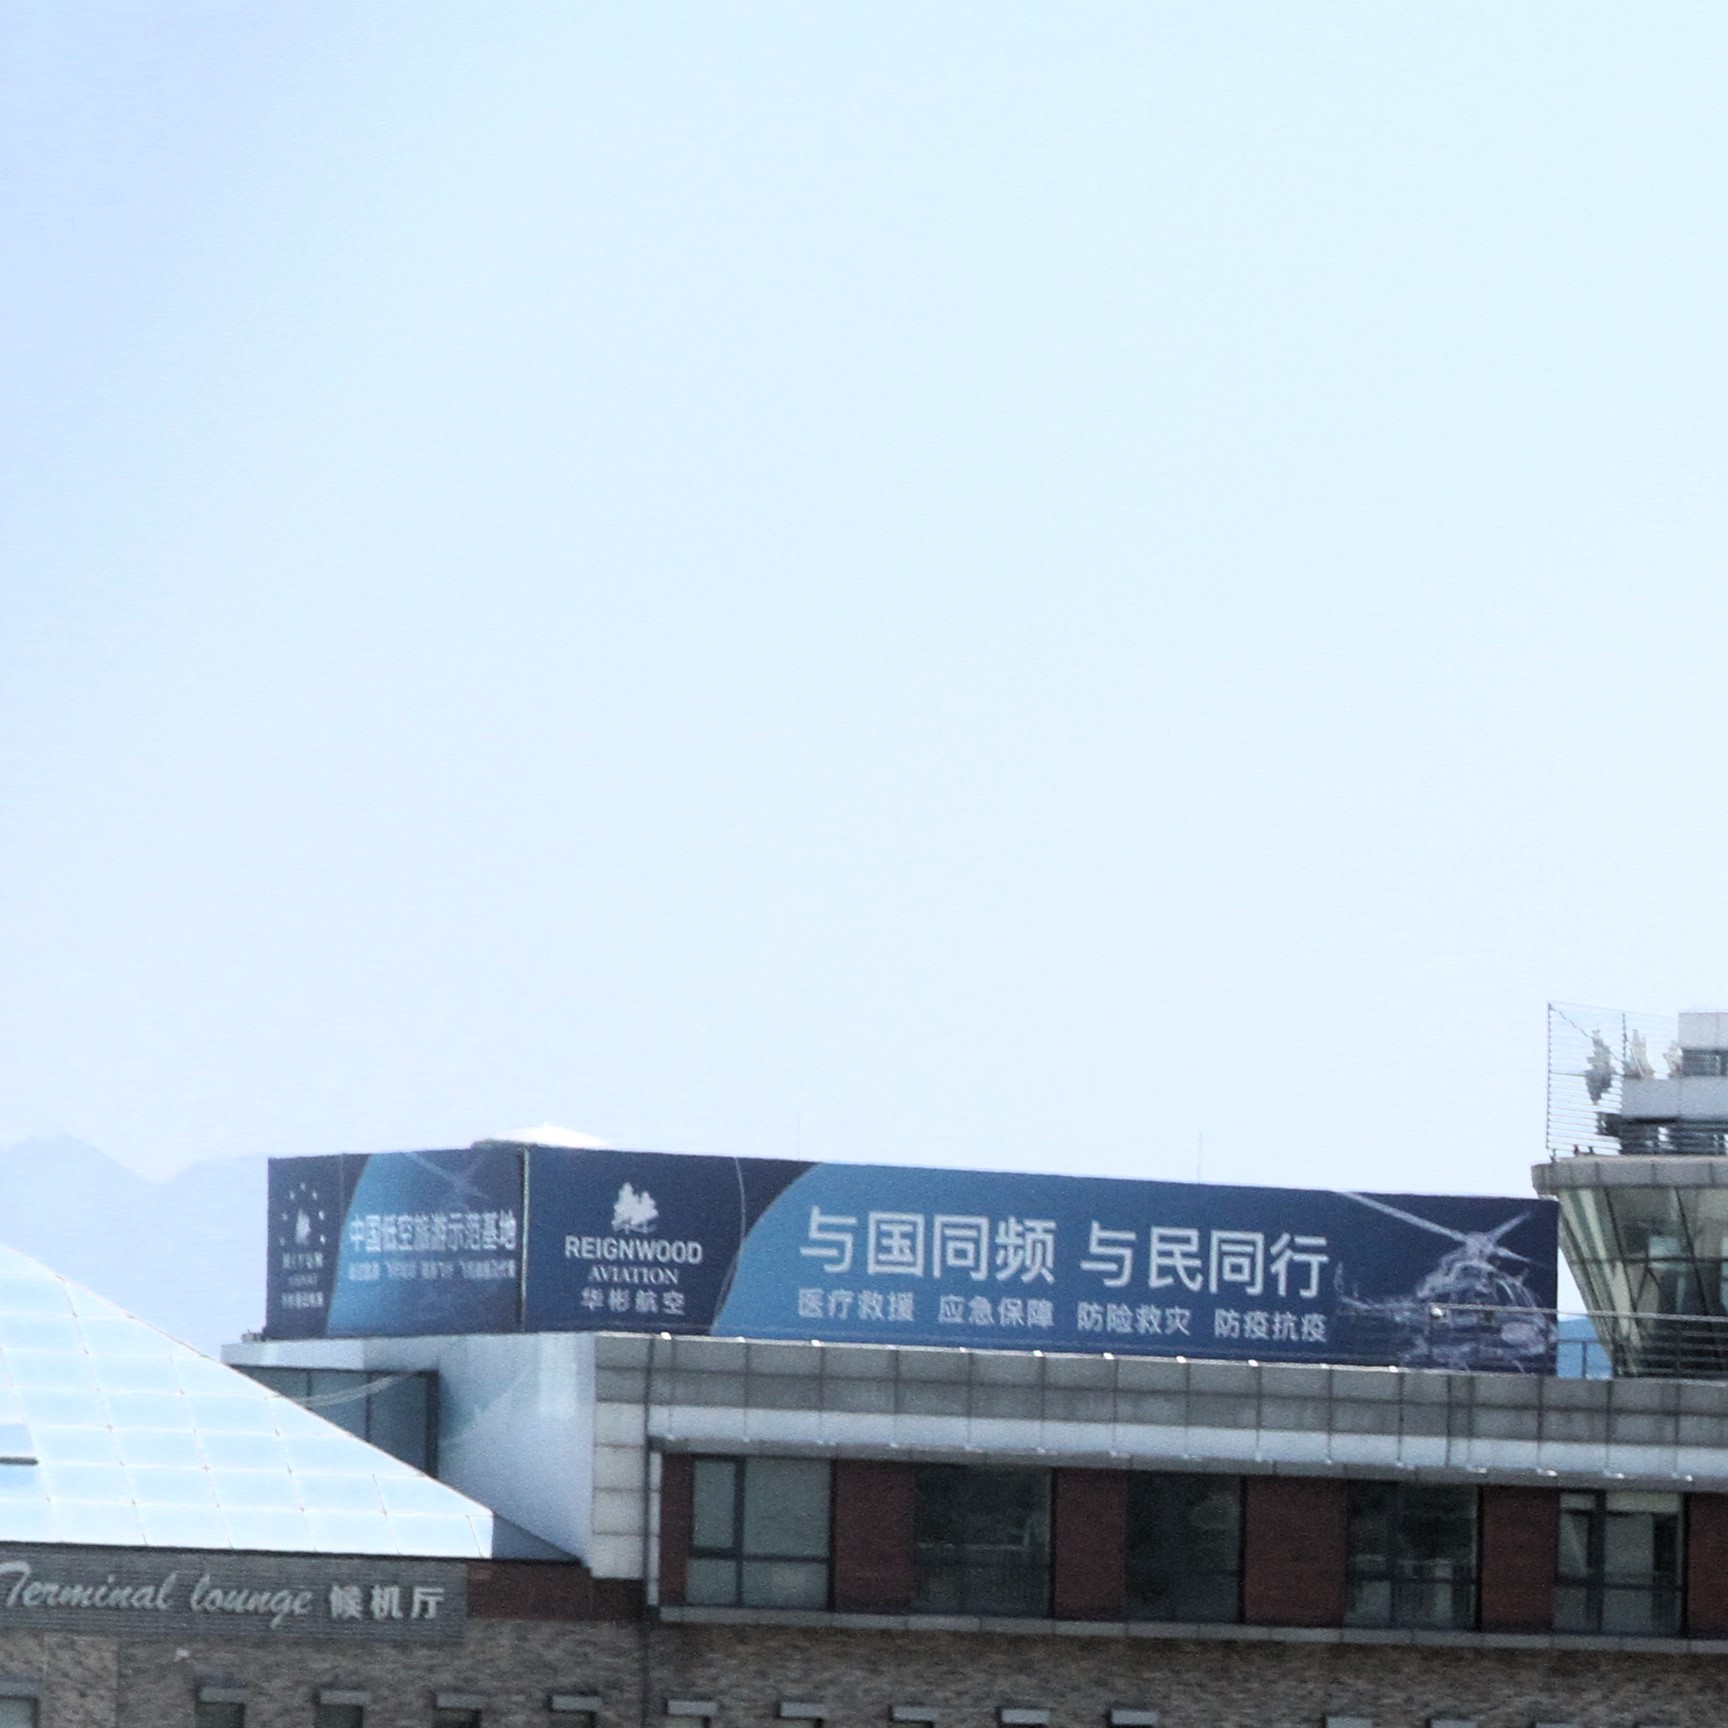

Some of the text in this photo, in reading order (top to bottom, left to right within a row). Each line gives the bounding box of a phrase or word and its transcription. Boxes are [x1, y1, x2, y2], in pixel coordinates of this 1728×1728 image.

[564, 1234, 703, 1265] REIGNWOOD
[800, 1205, 1329, 1298] 与国同频 与民同行
[588, 1264, 680, 1285] AVIATION
[580, 1285, 686, 1316] 华彬航空
[798, 1287, 915, 1323] 医疗救援
[937, 1294, 1054, 1329] 应急保障
[1214, 1307, 1327, 1343] 防疫抗疫
[0, 1560, 313, 1630] Terminal lounge
[328, 1582, 445, 1620] 候机厅
